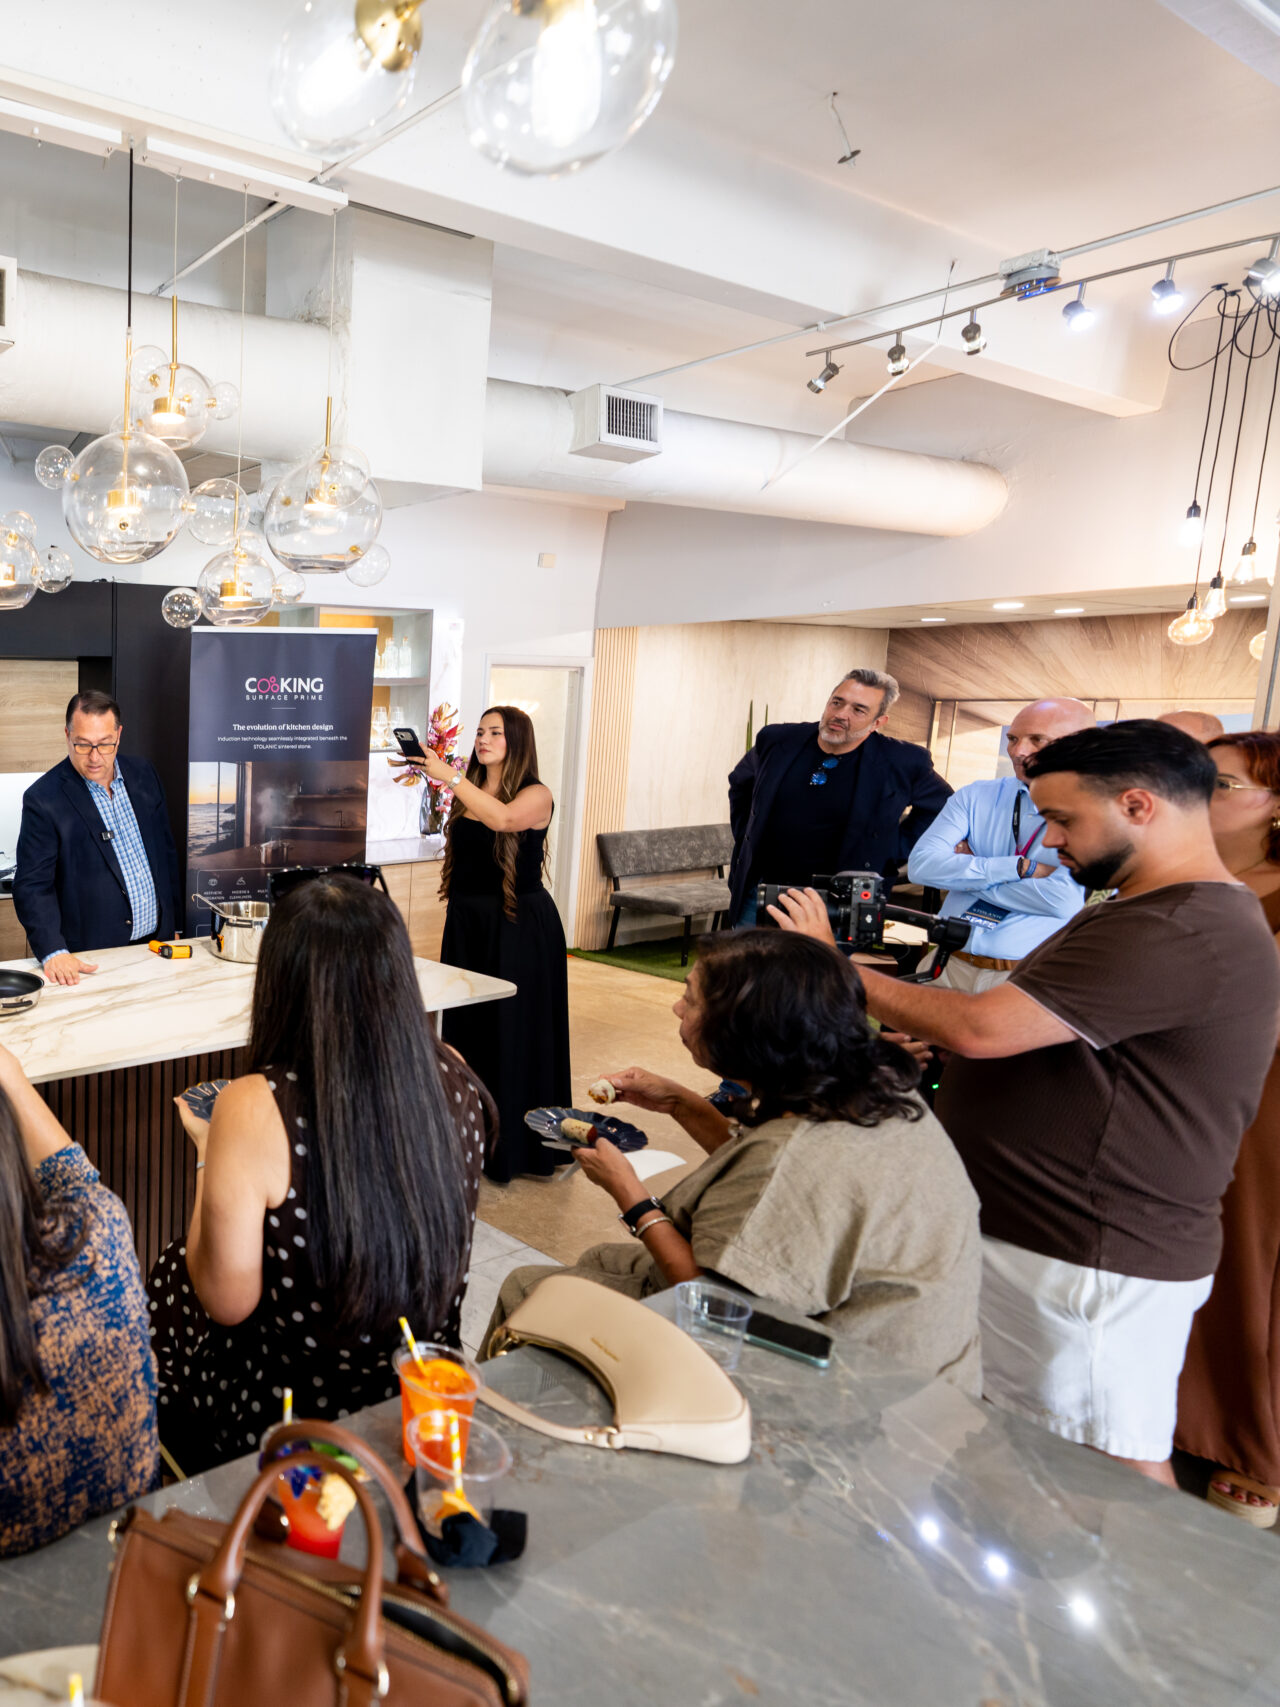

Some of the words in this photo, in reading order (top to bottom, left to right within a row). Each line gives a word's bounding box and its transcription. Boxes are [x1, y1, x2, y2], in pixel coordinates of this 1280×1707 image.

[245, 676, 324, 693] COOKING
[232, 723, 246, 731] The
[246, 723, 277, 731] evolution
[278, 723, 286, 731] of
[286, 723, 311, 731] kitchen
[311, 723, 334, 732] design
